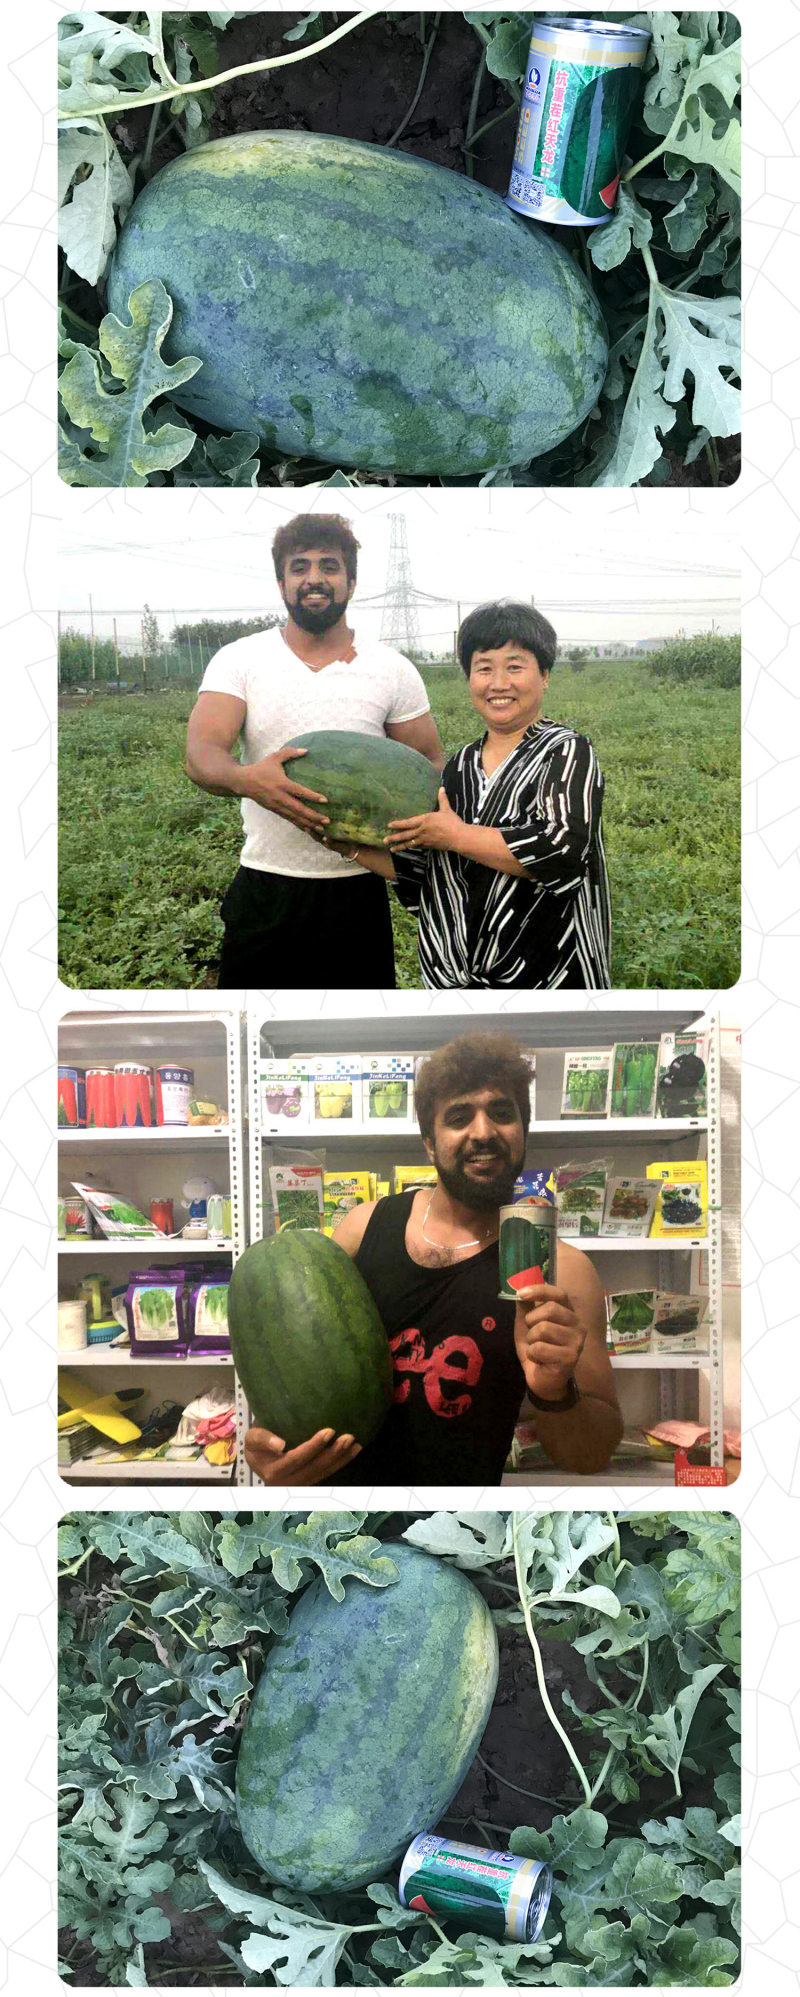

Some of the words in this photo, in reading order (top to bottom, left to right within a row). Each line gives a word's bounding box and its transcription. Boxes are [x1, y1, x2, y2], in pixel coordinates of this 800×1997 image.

[541, 69, 570, 164] 抗重茬红天龙
[445, 1856, 511, 1881] 抗重茬红天龙
